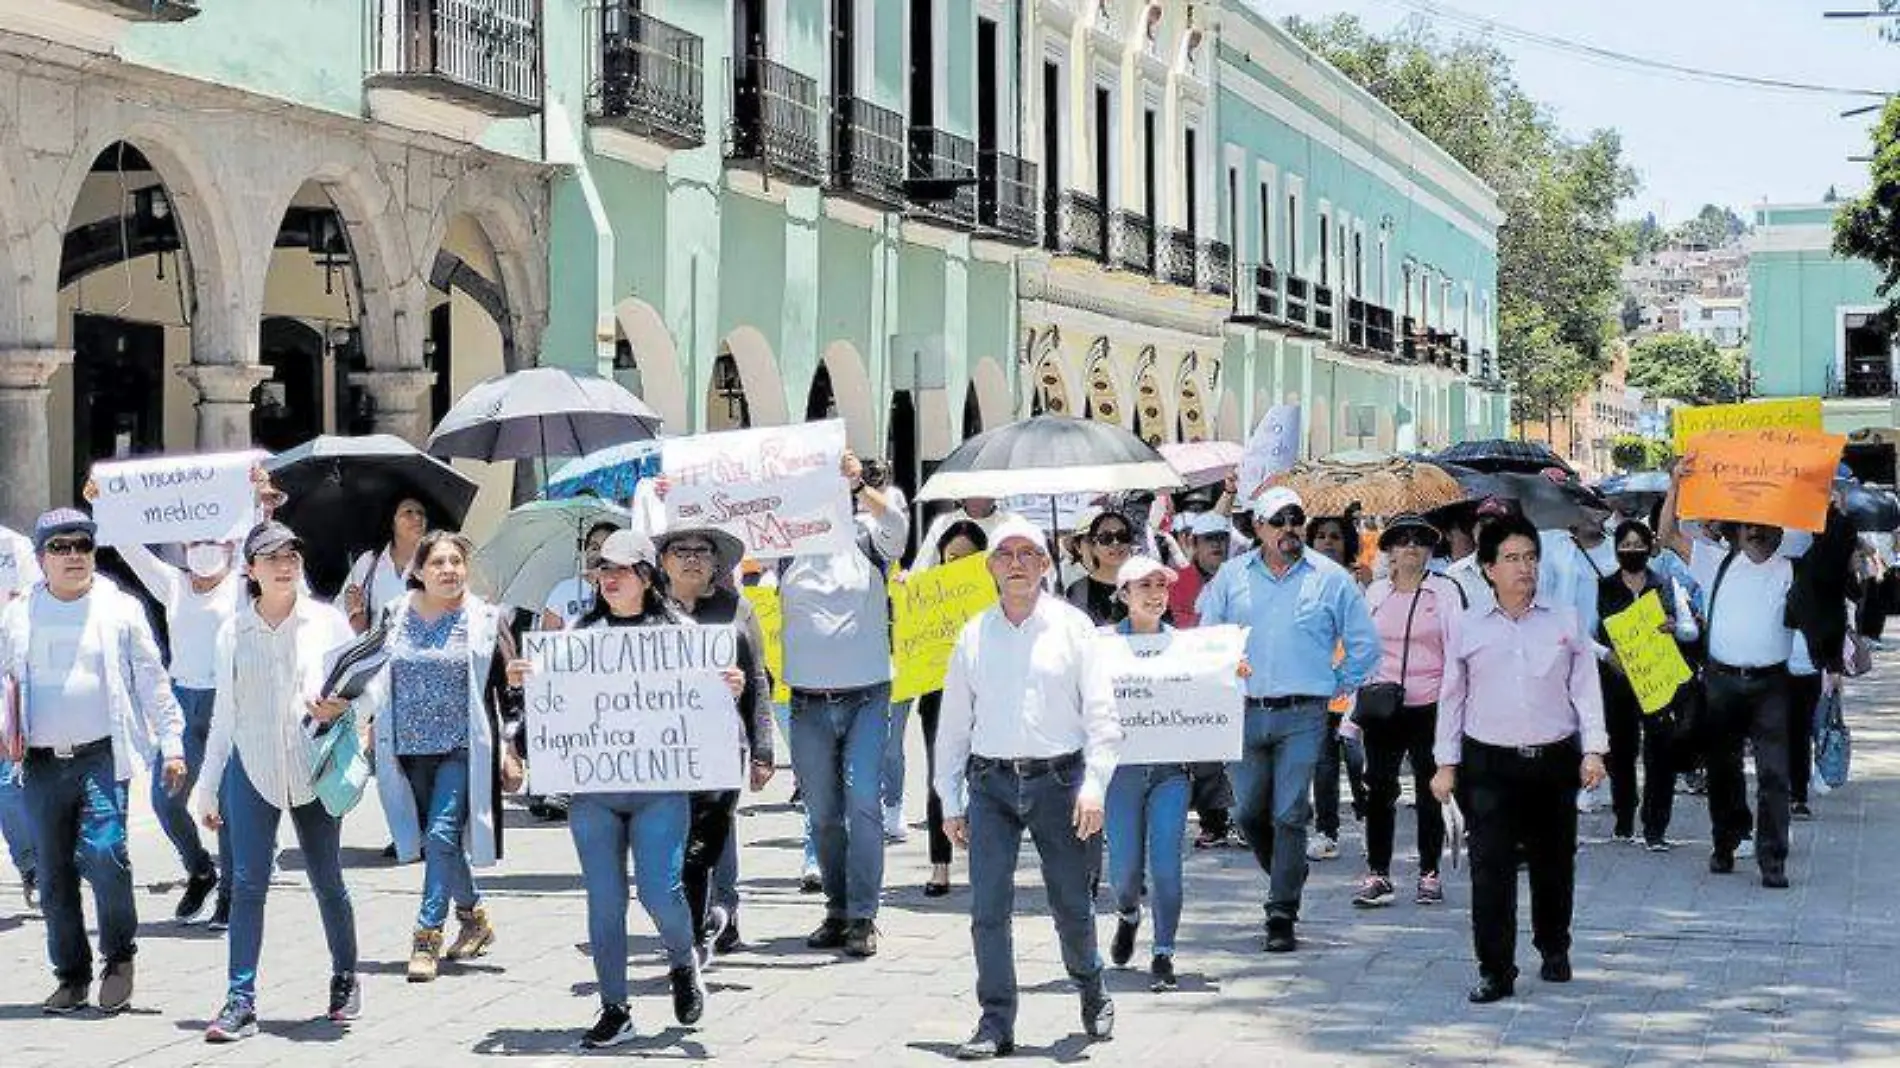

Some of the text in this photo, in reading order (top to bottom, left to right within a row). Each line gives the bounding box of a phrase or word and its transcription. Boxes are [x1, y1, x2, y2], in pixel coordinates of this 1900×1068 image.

[526, 629, 735, 675] MEDICAMENTO
[533, 679, 705, 722] de patente
[532, 714, 689, 759] dignifica al
[572, 747, 705, 786] DOCENTE
